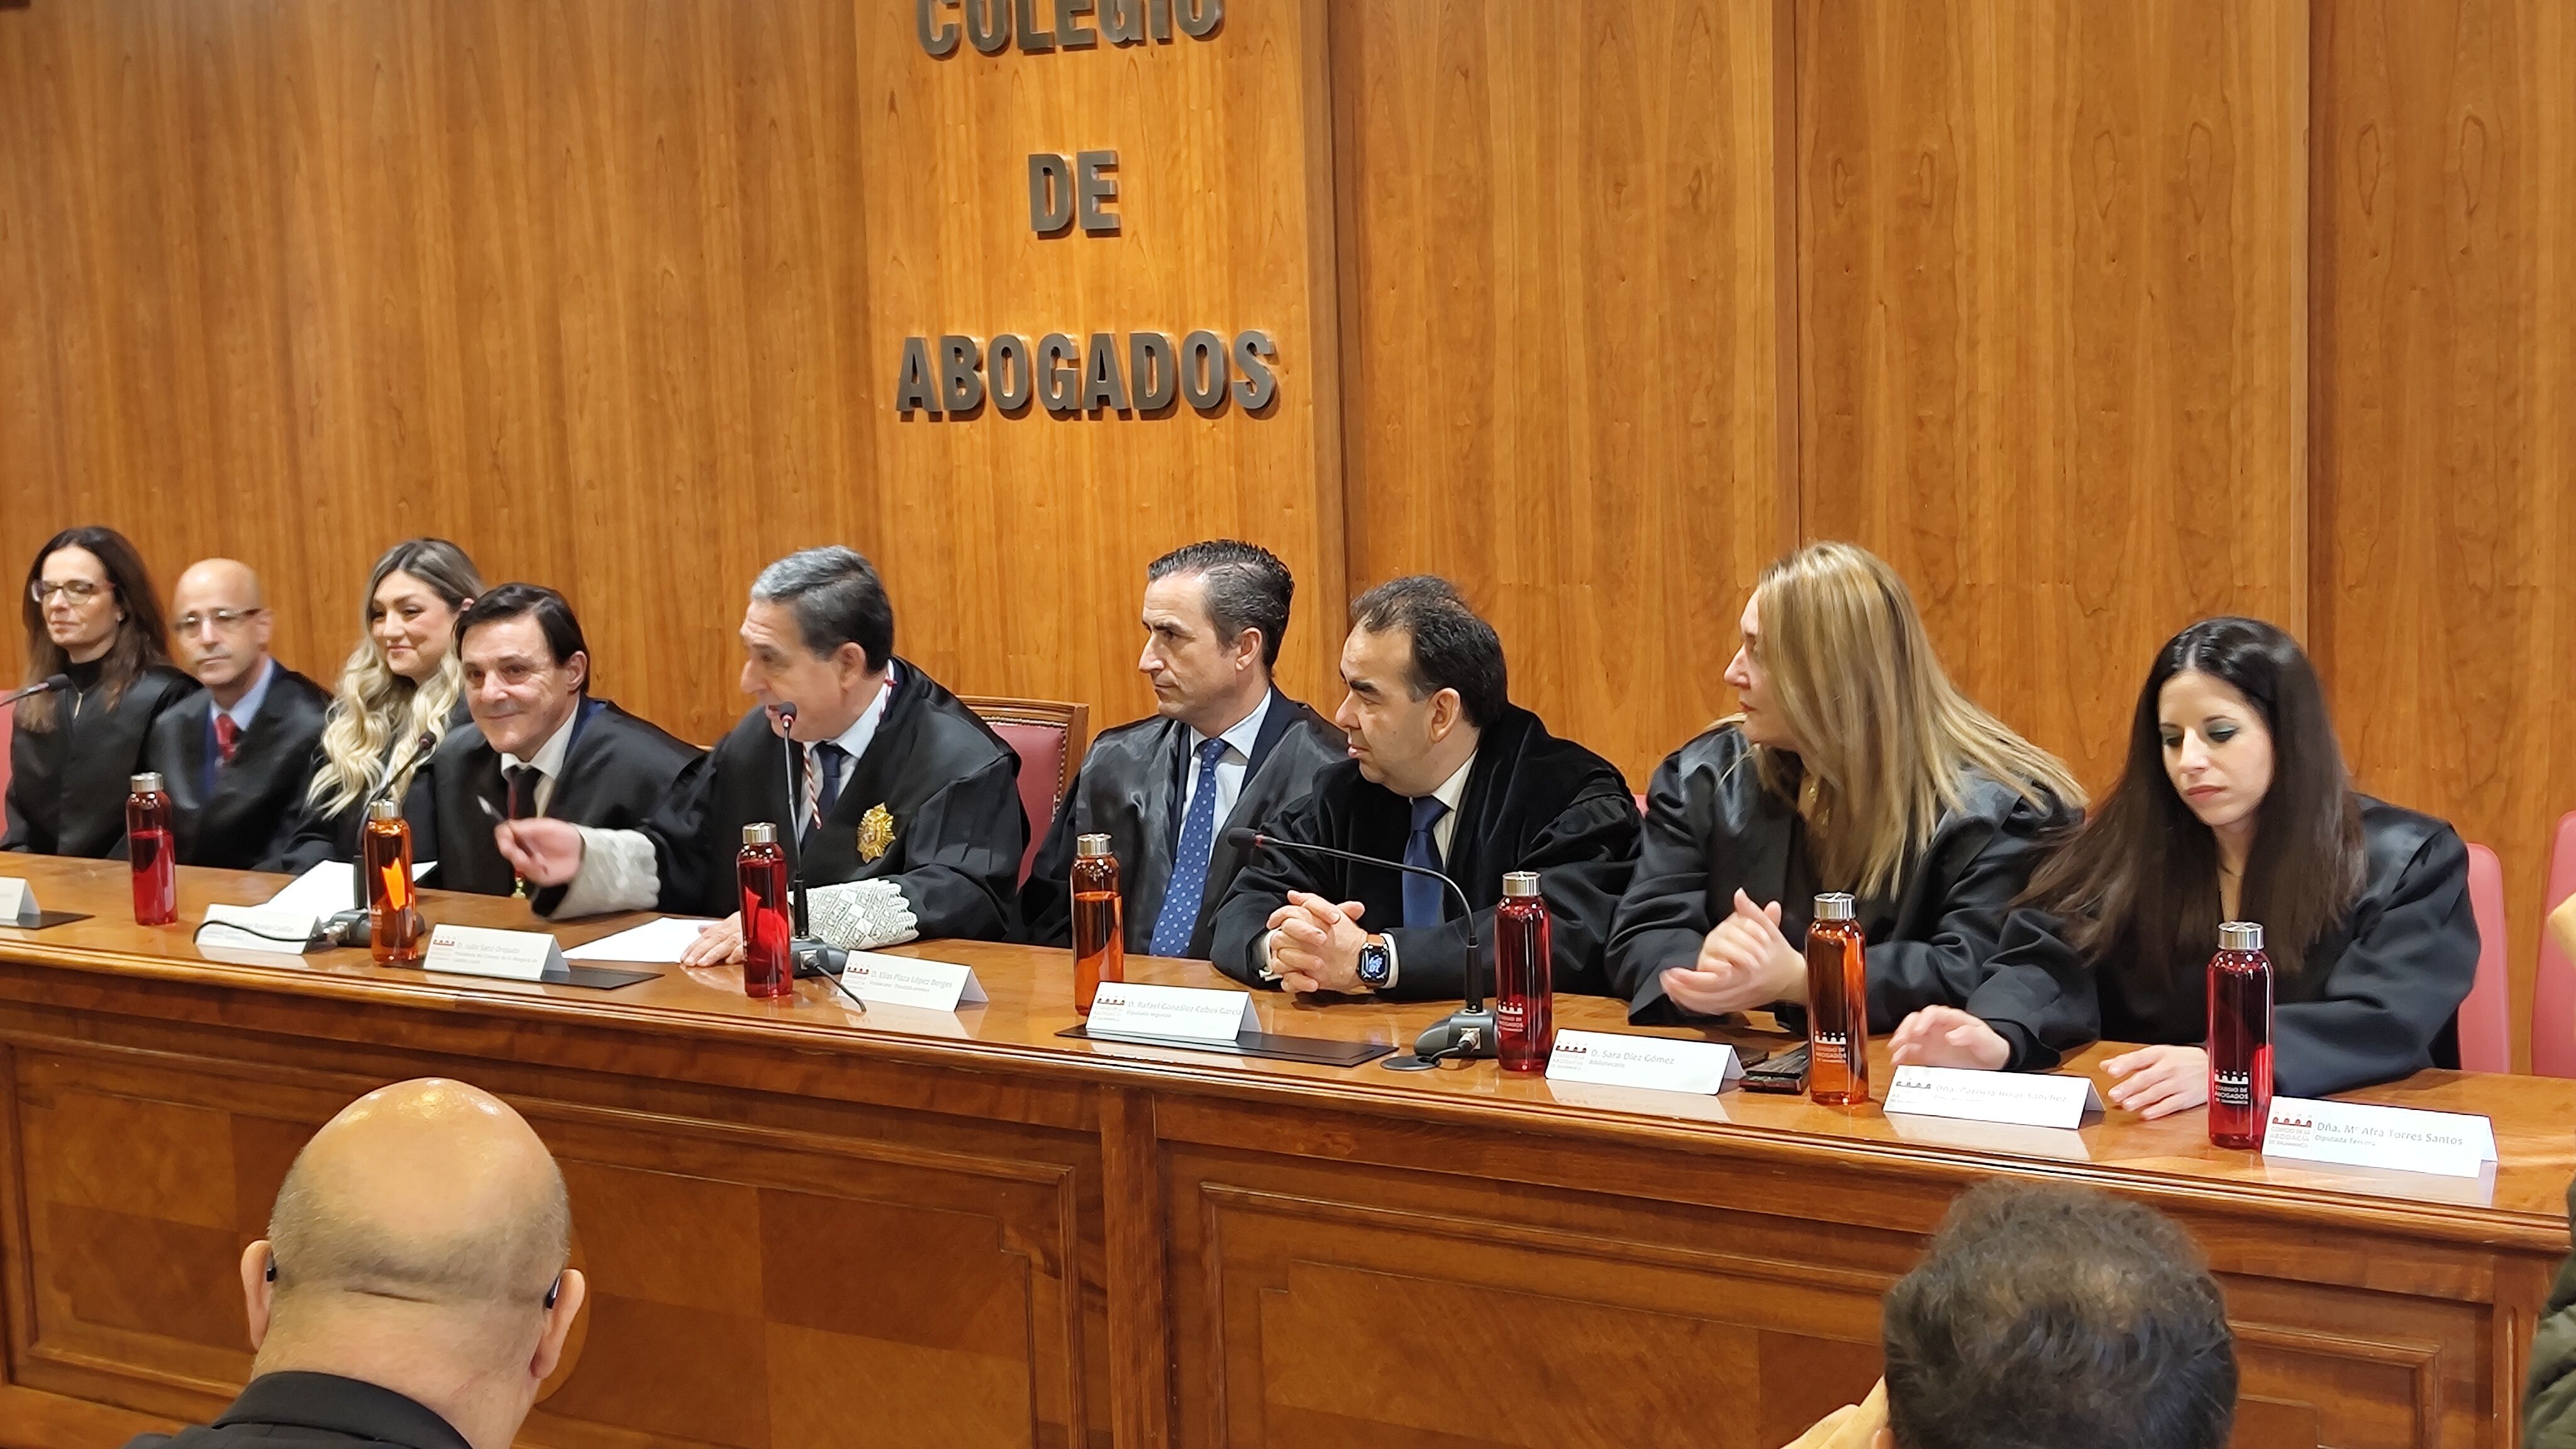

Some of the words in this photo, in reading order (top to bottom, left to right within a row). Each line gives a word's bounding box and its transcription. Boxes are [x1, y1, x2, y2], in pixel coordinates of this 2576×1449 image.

[1028, 150, 1120, 233] DE
[896, 330, 1277, 413] ABOGADOS
[1162, 1003, 1194, 1012] González
[1196, 1006, 1218, 1014] Cobos
[1591, 1049, 1600, 1057] D.
[1602, 1050, 1621, 1059] Sara
[1645, 1054, 1675, 1065] Gómez
[2214, 1091, 2249, 1100] ABOGADOS
[2317, 1122, 2341, 1133] Dña.
[2362, 1127, 2384, 1138] Afra
[2389, 1129, 2423, 1141] Torres
[2426, 1133, 2463, 1146] Santos
